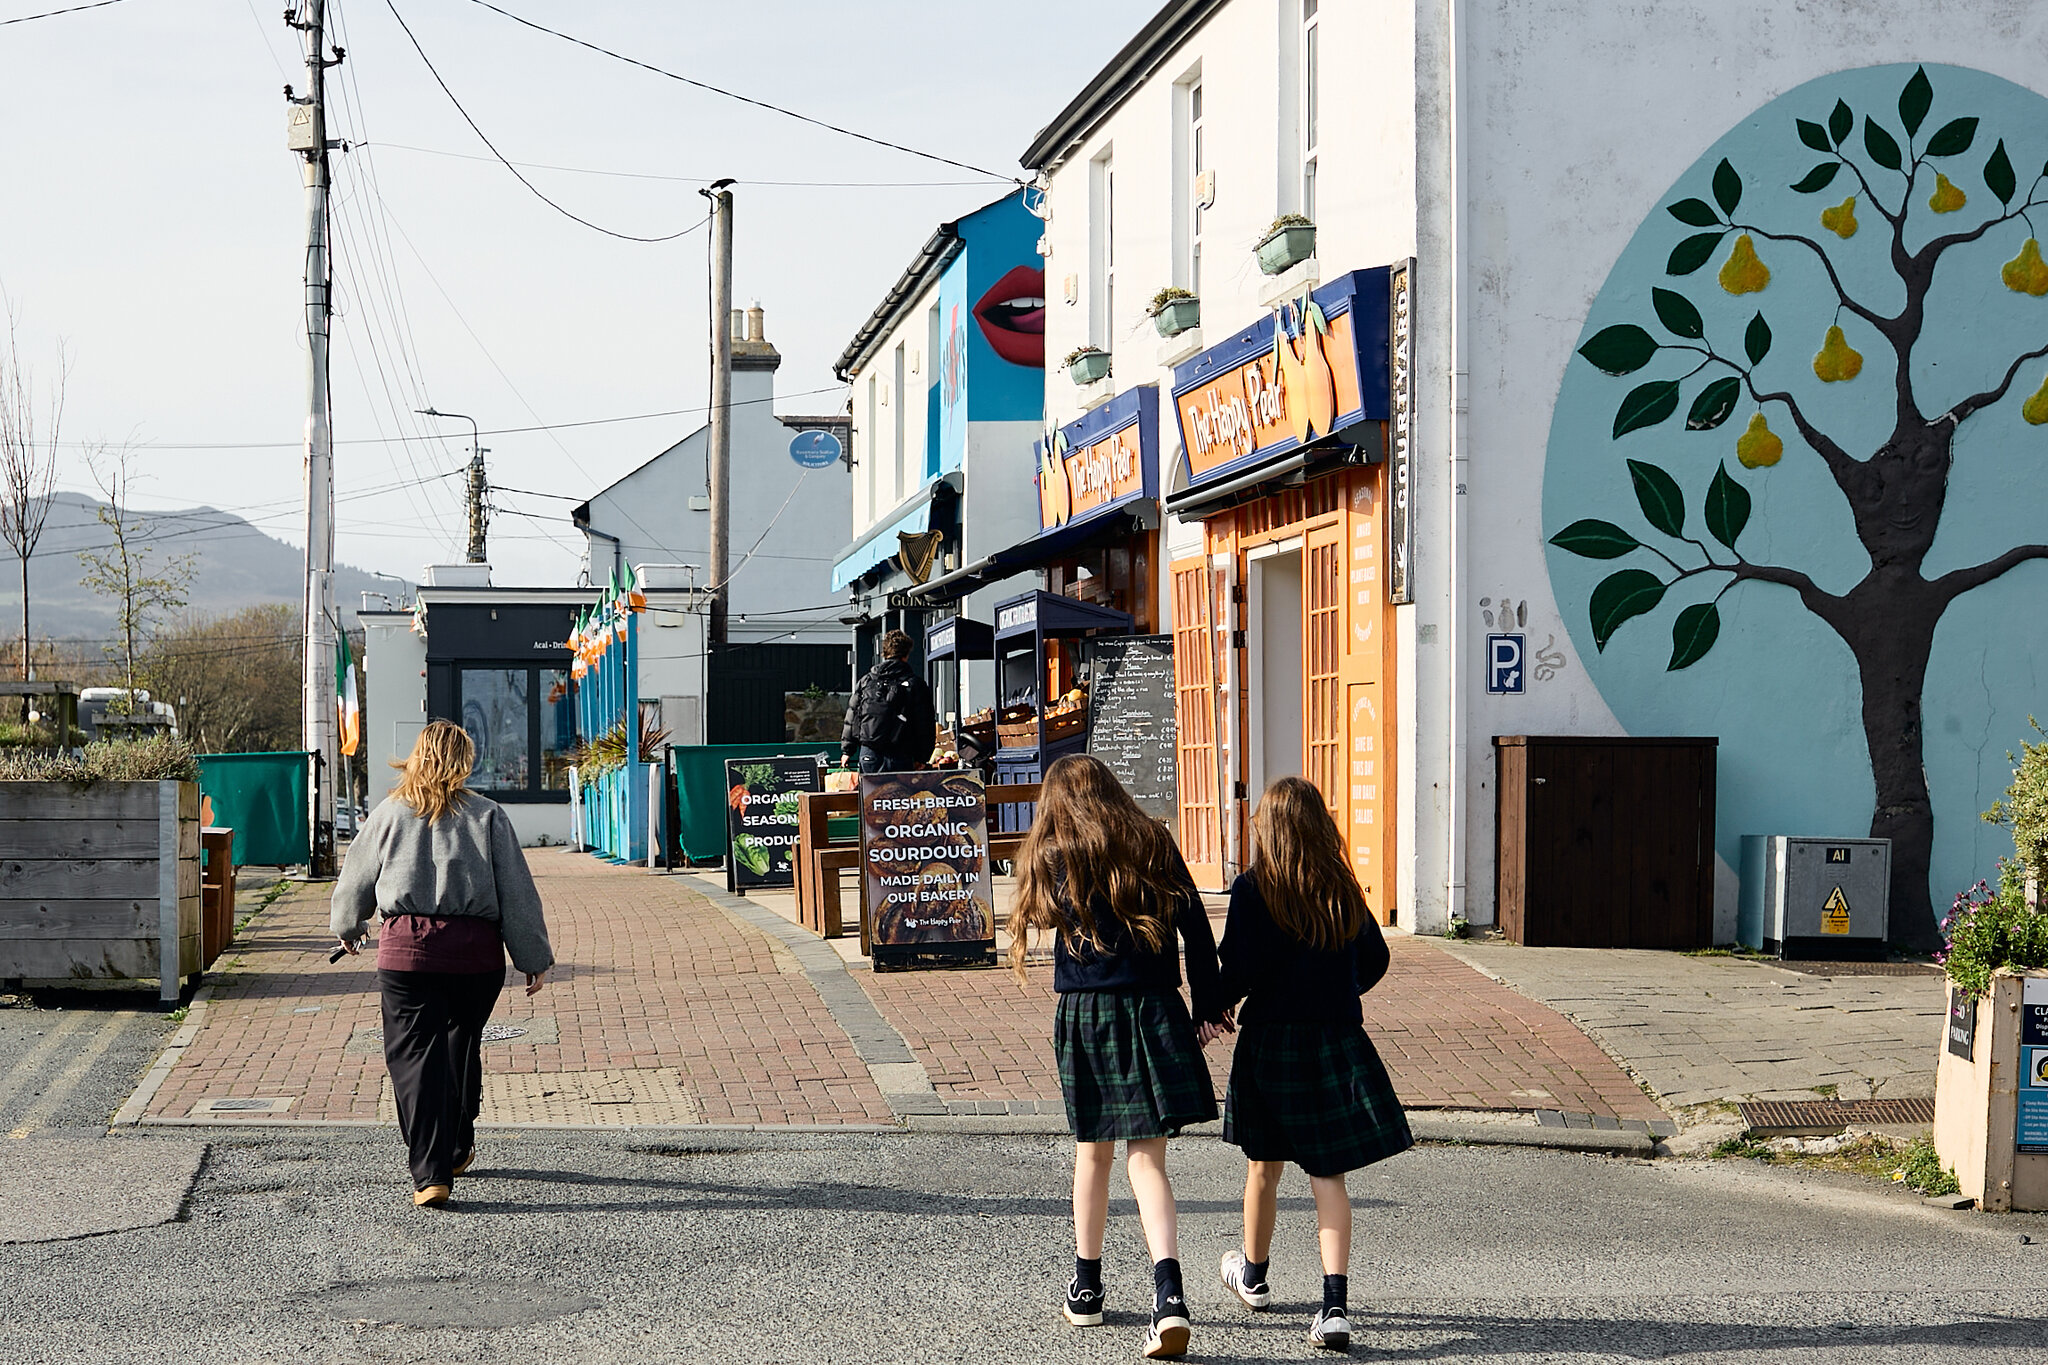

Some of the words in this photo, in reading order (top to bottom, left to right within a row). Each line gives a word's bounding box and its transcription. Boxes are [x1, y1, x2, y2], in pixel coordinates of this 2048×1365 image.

[1397, 291, 1408, 509] COURTYARD
[1188, 405, 1213, 454] The
[1207, 387, 1253, 456] Happy
[1246, 369, 1281, 427] Pear
[1071, 459, 1087, 498] The
[1084, 446, 1113, 503] Happy
[1110, 434, 1131, 482] Pear
[533, 641, 548, 649] Acai
[1492, 640, 1520, 688] P
[741, 793, 799, 805] ORGANIC
[873, 798, 921, 811] FRESH
[925, 796, 977, 809] BREAD
[743, 814, 800, 826] SEASON
[885, 822, 968, 838] ORGANIC
[745, 835, 800, 847] PRODUC
[869, 844, 986, 862] SOURDOUGH
[880, 875, 920, 887] MADE
[923, 873, 962, 885] DAILY
[965, 872, 979, 883] IN
[887, 893, 917, 903] OUR
[920, 889, 974, 902] BAKERY
[930, 918, 948, 927] Happy
[948, 916, 961, 924] Pear
[1951, 1025, 1969, 1045] PARKING
